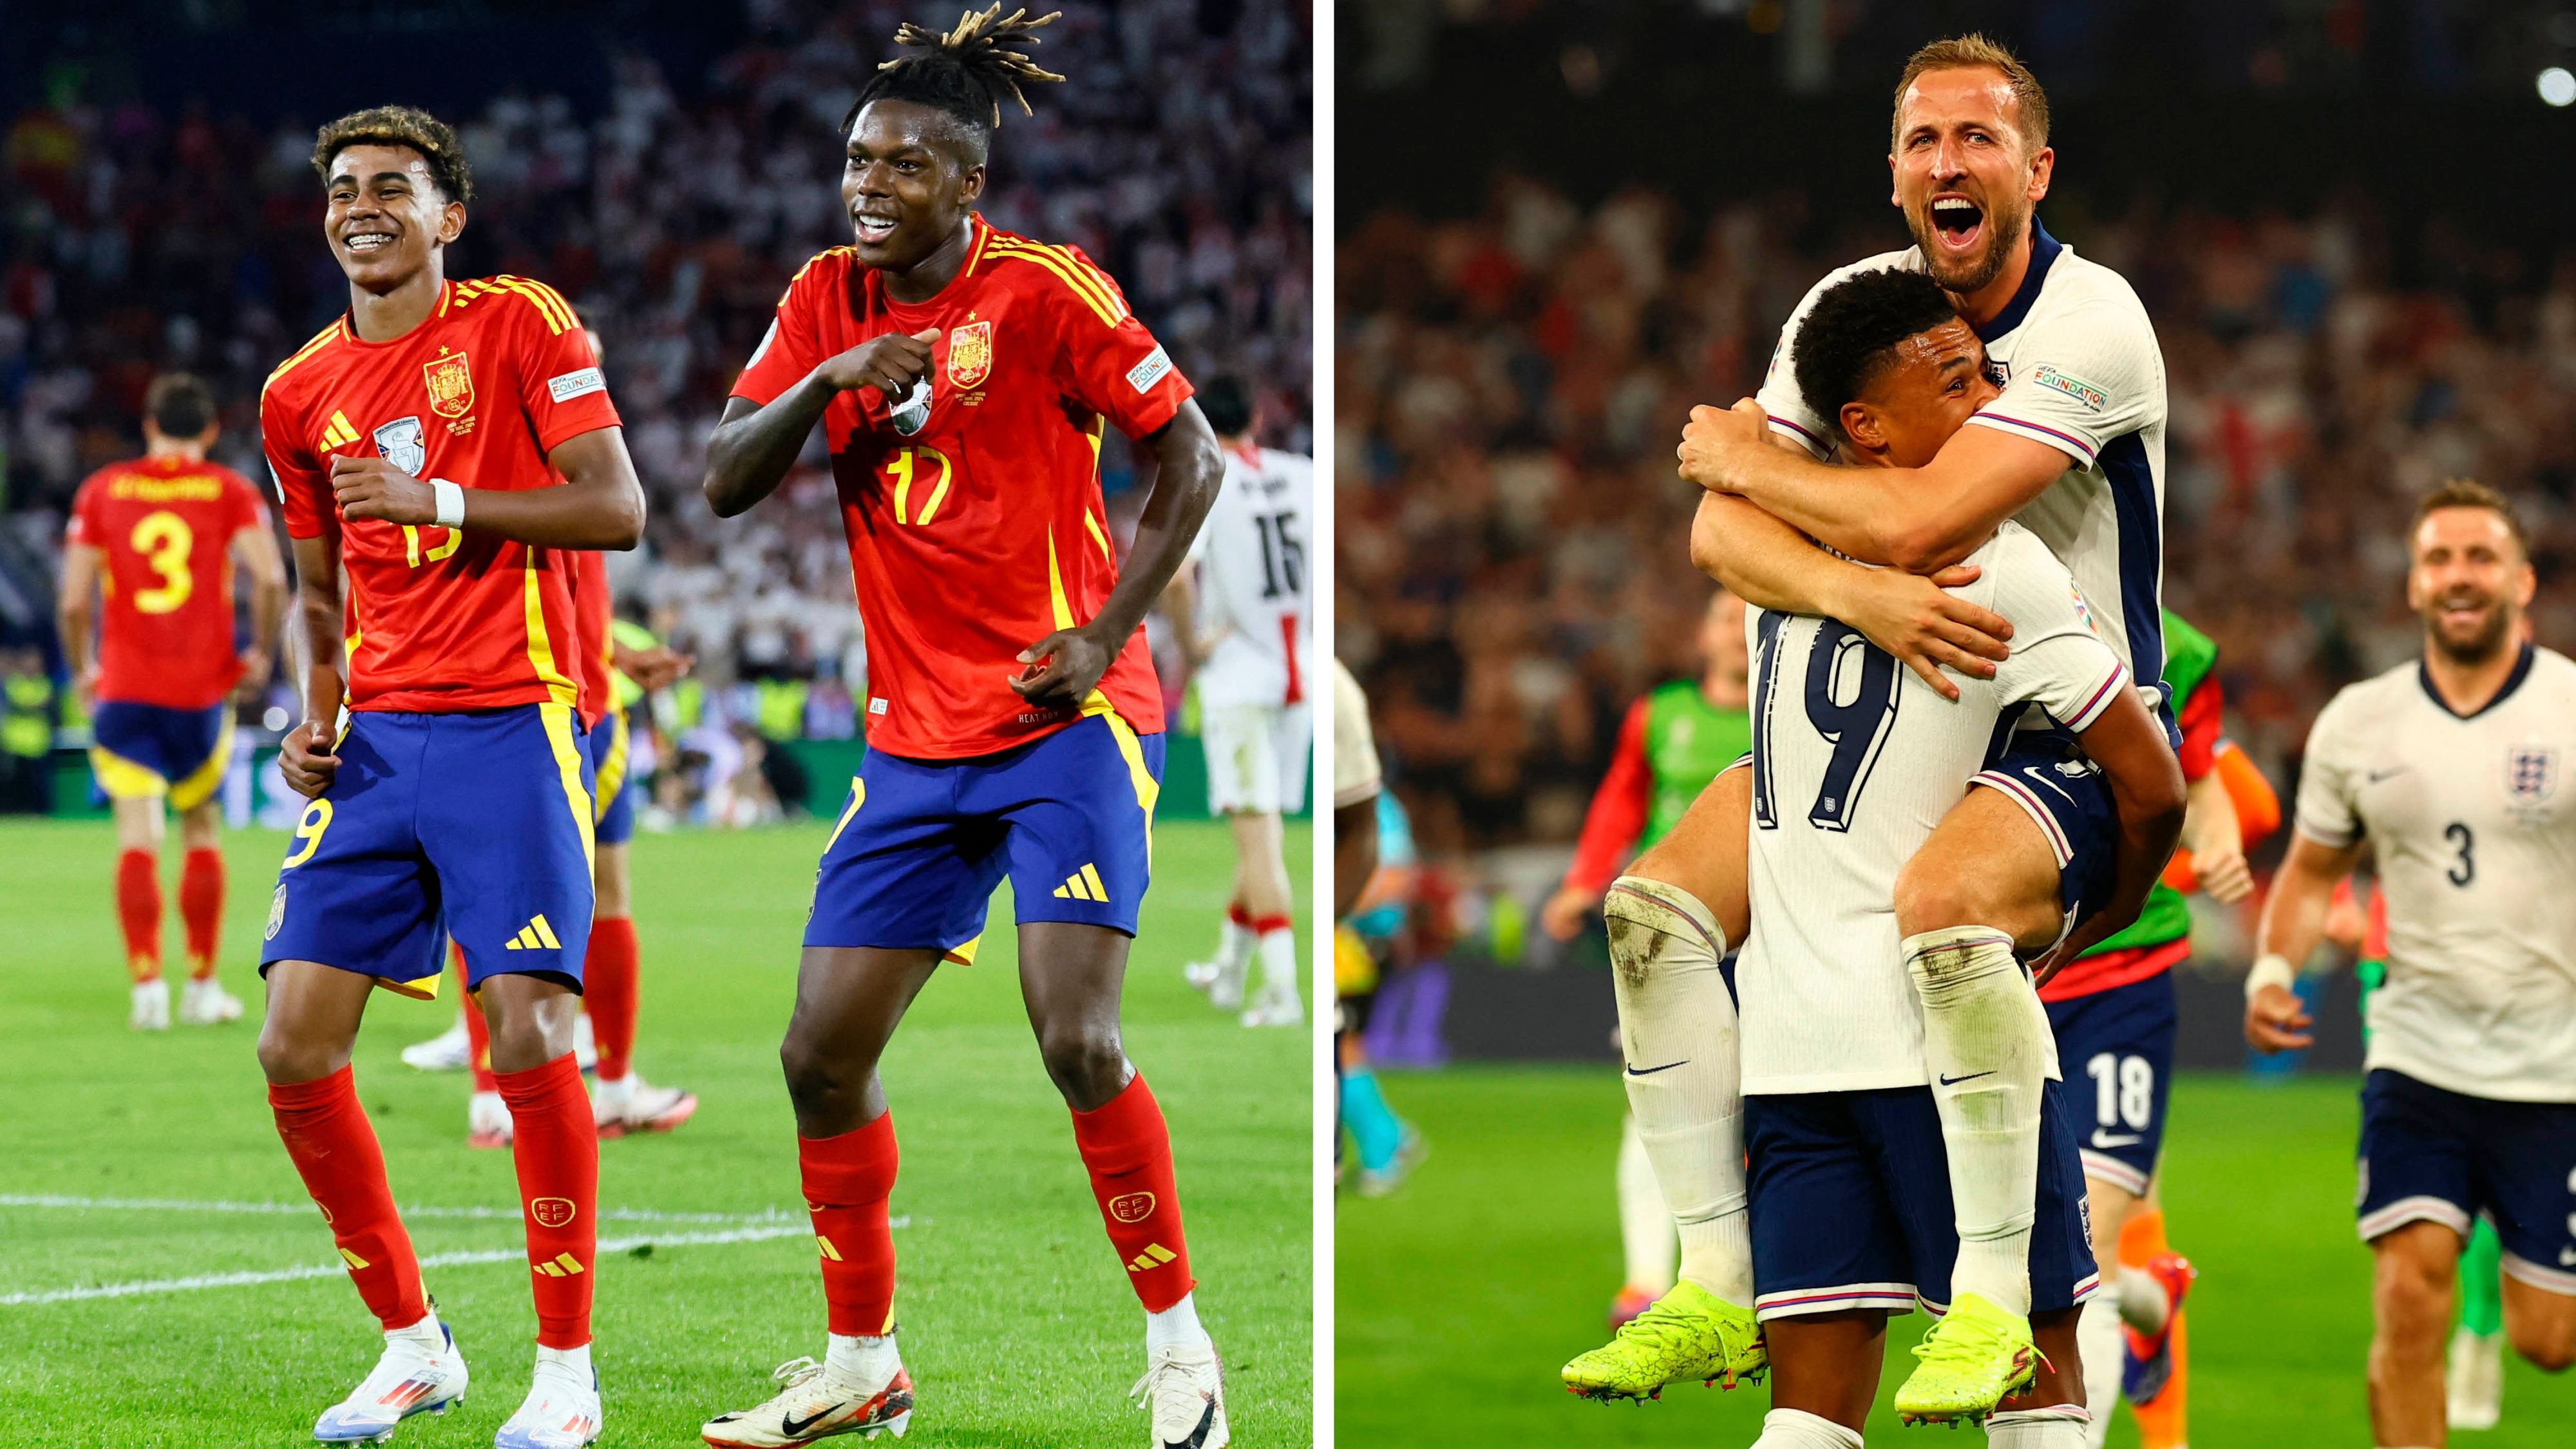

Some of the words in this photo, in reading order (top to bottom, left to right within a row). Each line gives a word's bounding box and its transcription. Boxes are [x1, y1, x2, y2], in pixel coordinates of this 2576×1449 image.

[2034, 371, 2107, 407] FOUNDATION
[2038, 365, 2057, 375] UEFA
[886, 446, 952, 526] 17
[129, 509, 193, 614] 3
[1755, 609, 1904, 833] 19
[2444, 822, 2474, 887] 3
[2085, 1051, 2155, 1132] 18
